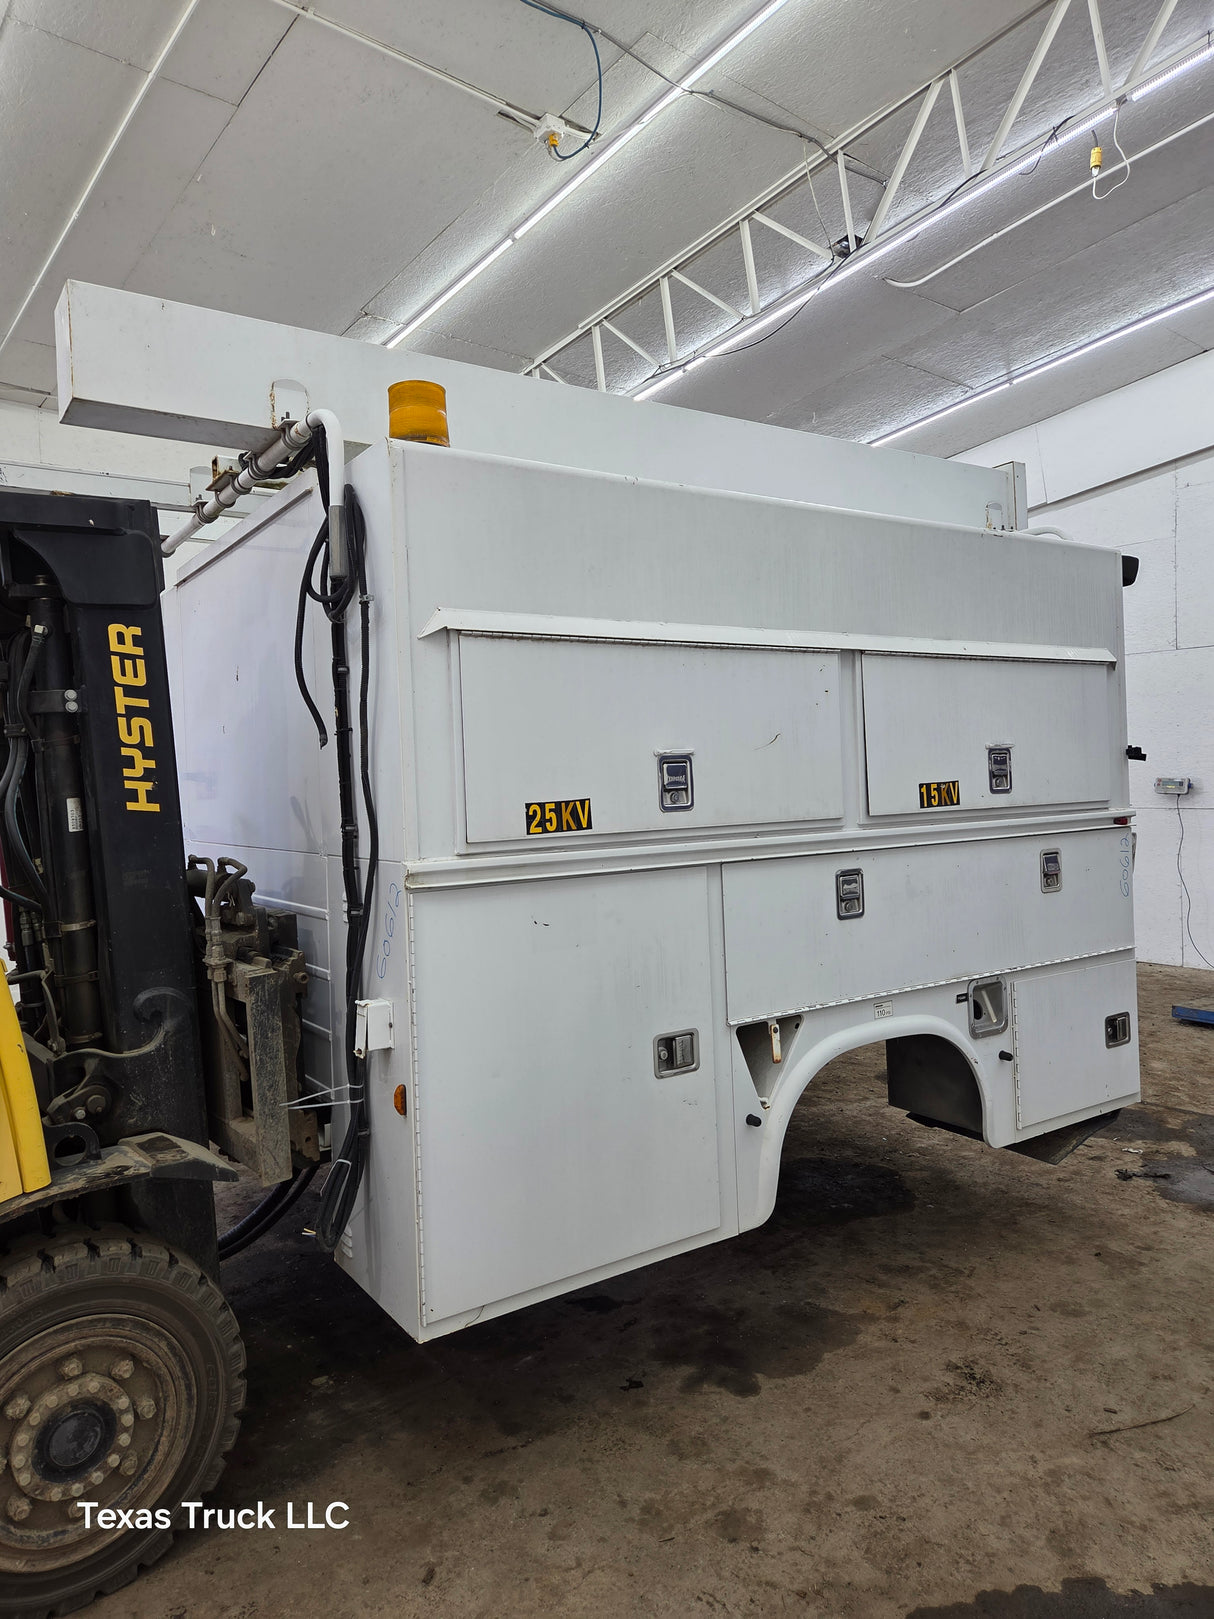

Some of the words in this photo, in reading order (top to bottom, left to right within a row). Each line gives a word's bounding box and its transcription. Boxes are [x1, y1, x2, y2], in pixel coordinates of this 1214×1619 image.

[107, 623, 161, 812] HYSTER
[528, 800, 590, 833] 25KV
[920, 781, 959, 808] 15KV
[1119, 833, 1130, 898] 60612
[376, 882, 402, 979] 60612
